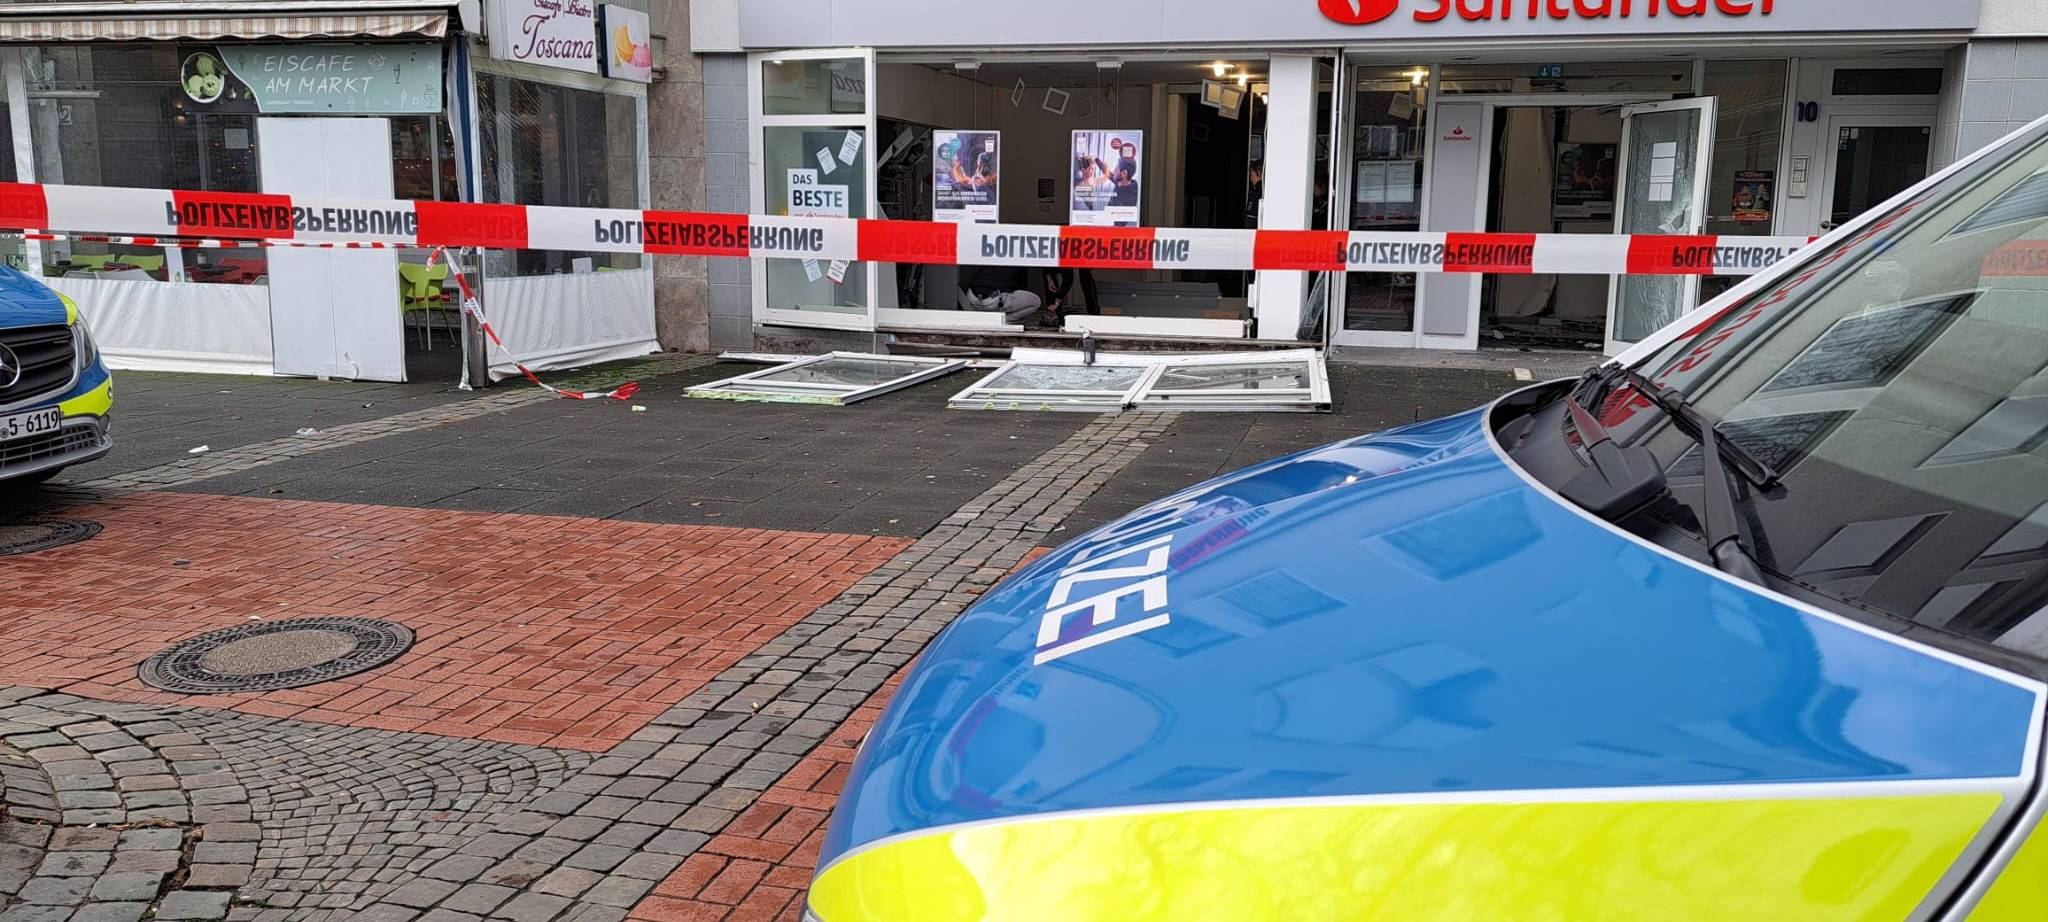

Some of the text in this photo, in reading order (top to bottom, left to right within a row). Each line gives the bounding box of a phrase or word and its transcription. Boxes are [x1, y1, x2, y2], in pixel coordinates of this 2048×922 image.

[513, 15, 593, 59] Toscana
[264, 55, 356, 72] EISCAFE
[265, 76, 375, 94] AM MARKT
[1797, 101, 1818, 122] 10
[792, 174, 812, 185] DAS
[793, 190, 843, 208] BESTE
[9, 411, 58, 435] 5-6119
[1034, 488, 1208, 666] OLIZEI
